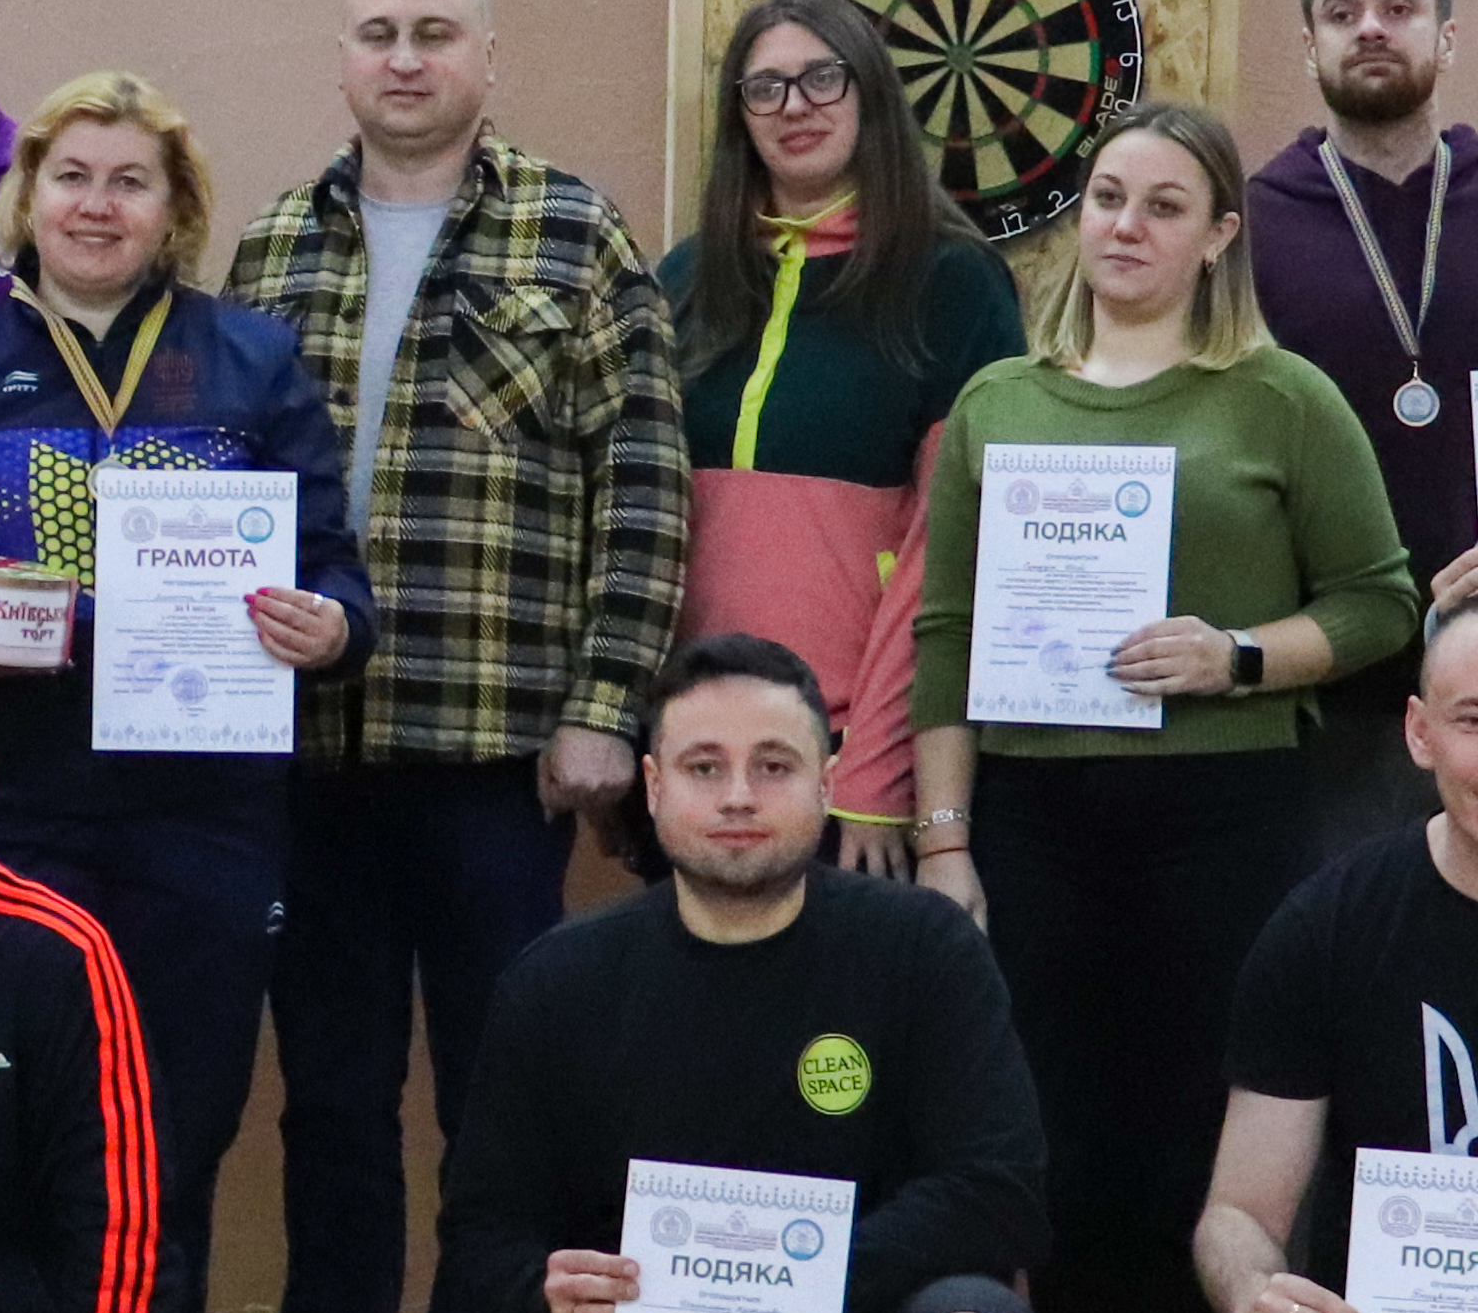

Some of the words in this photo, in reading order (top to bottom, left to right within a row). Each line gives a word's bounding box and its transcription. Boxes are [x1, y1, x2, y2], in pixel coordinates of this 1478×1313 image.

[1023, 520, 1128, 545] ПОДЯКА
[136, 548, 258, 568] ГРАМОТА
[803, 1053, 864, 1075] CLEAN
[807, 1074, 864, 1095] SPACE
[671, 1254, 794, 1288] ПОДЯКА
